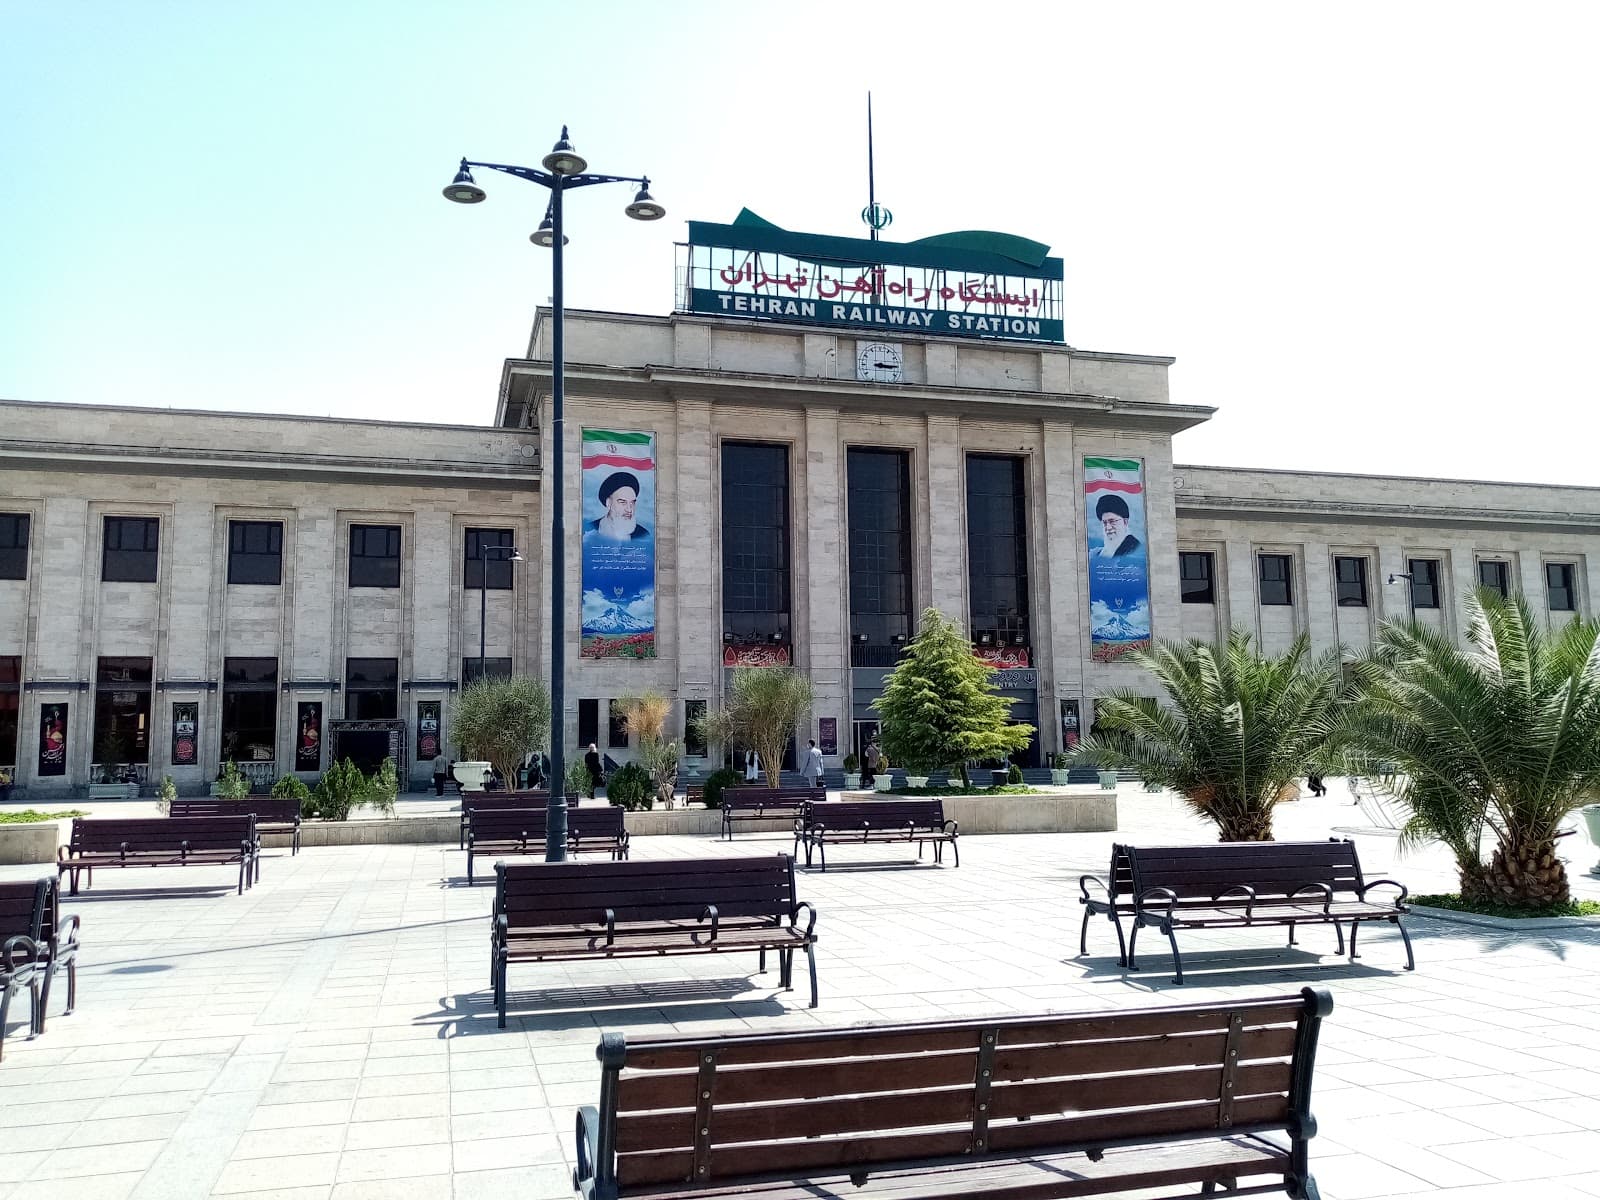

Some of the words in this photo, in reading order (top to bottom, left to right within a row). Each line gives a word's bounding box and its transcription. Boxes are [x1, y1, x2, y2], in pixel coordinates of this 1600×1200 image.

[720, 262, 808, 293] تهران
[817, 268, 887, 298] آهن
[888, 277, 931, 303] راه
[941, 279, 1038, 312] ایستگاه
[718, 294, 816, 316] TEHRAN
[832, 304, 934, 327] RAILWAY
[947, 314, 1041, 335] STATION
